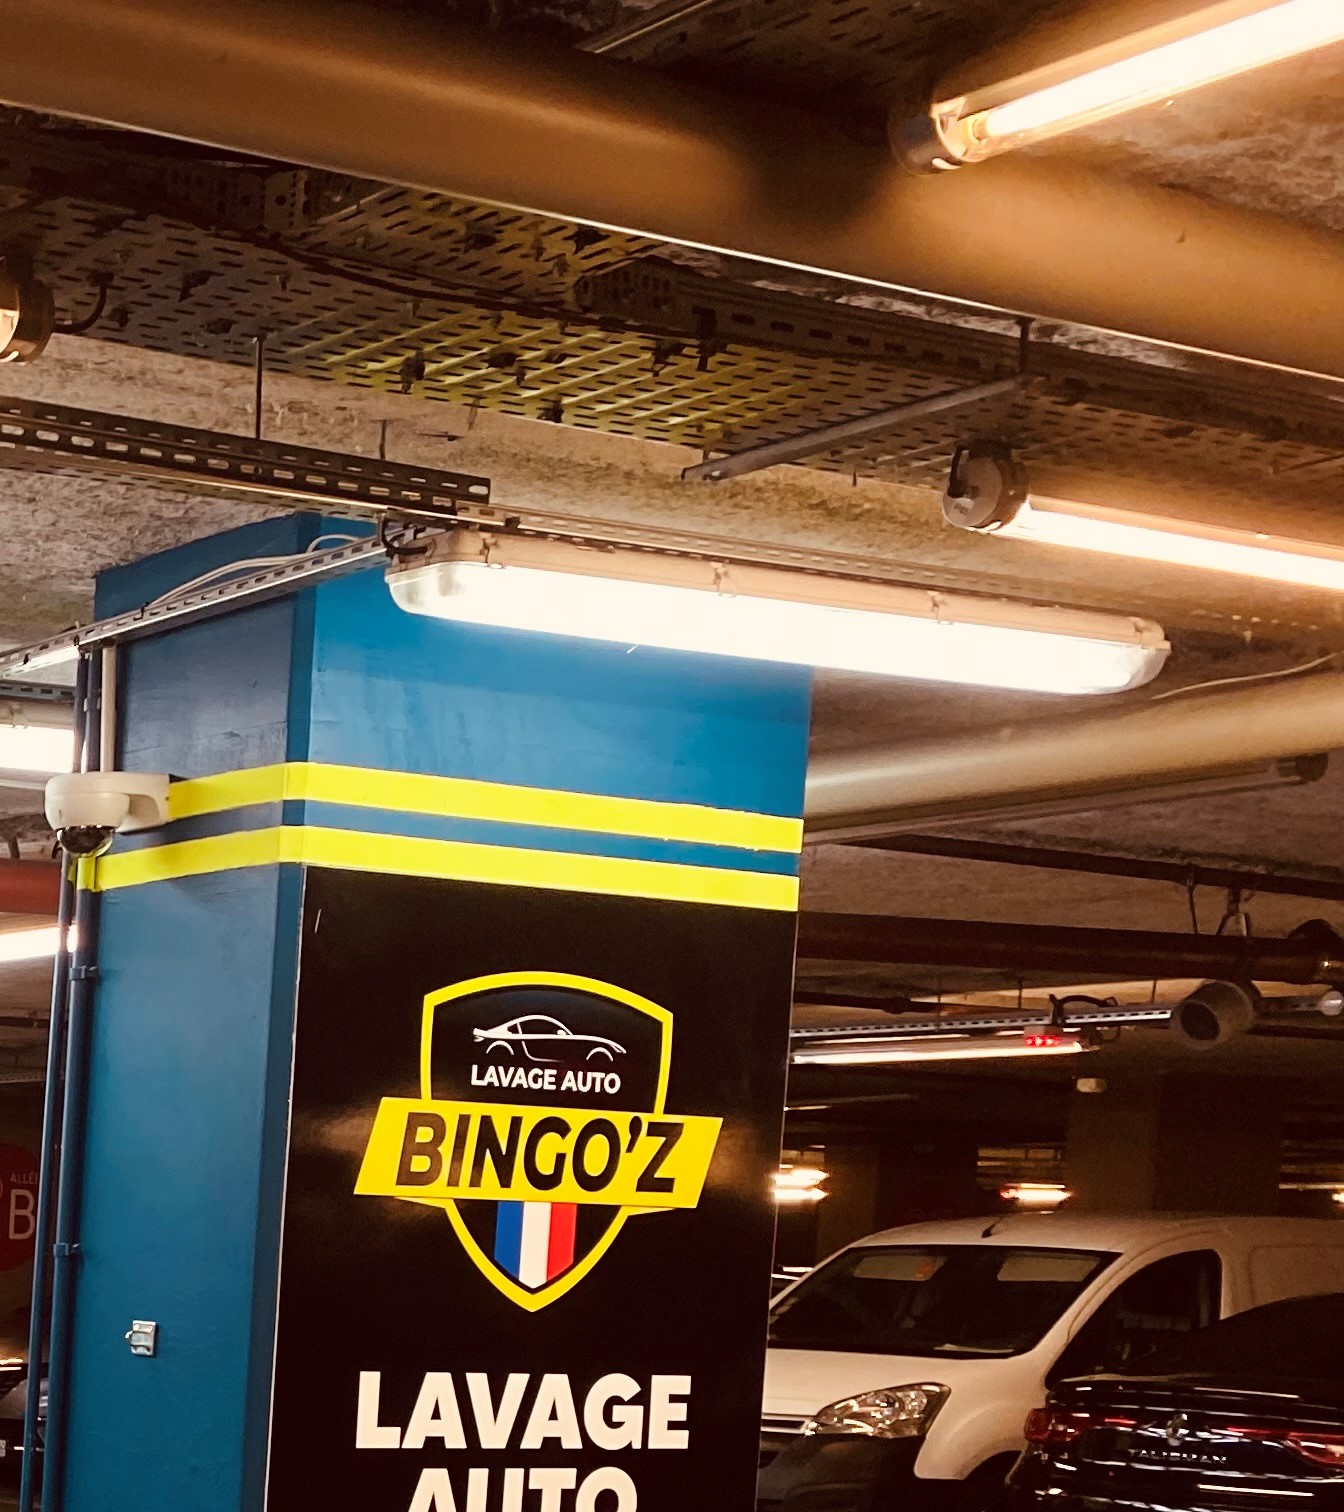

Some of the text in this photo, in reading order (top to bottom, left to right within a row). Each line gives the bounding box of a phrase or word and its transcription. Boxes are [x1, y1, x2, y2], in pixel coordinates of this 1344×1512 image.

[470, 1064, 622, 1094] LAVAGE AUTO
[395, 1112, 686, 1194] BINGO'Z
[355, 1371, 692, 1451] LAVAGE
